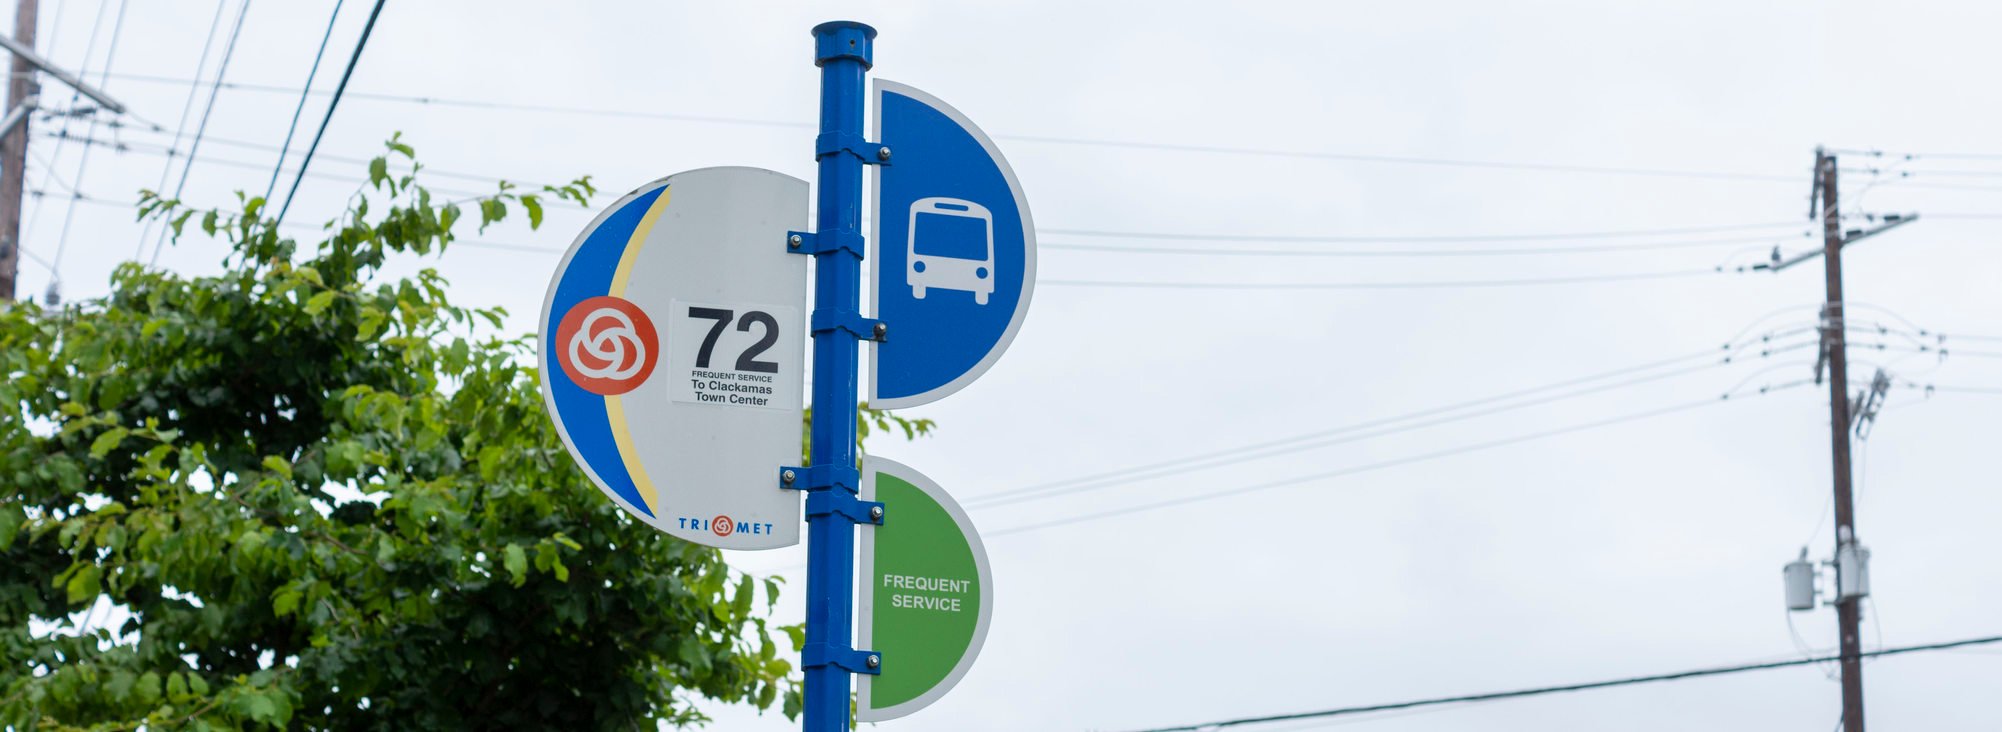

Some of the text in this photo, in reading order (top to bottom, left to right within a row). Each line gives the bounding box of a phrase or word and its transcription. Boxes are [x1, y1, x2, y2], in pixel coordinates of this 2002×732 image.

[688, 306, 780, 374] 72
[691, 370, 773, 383] FREQUENT SERVICE
[691, 379, 773, 395] To Clackamas
[695, 391, 769, 406] Town Center
[883, 574, 970, 594] FREQUENT
[892, 594, 961, 612] SERVICE
